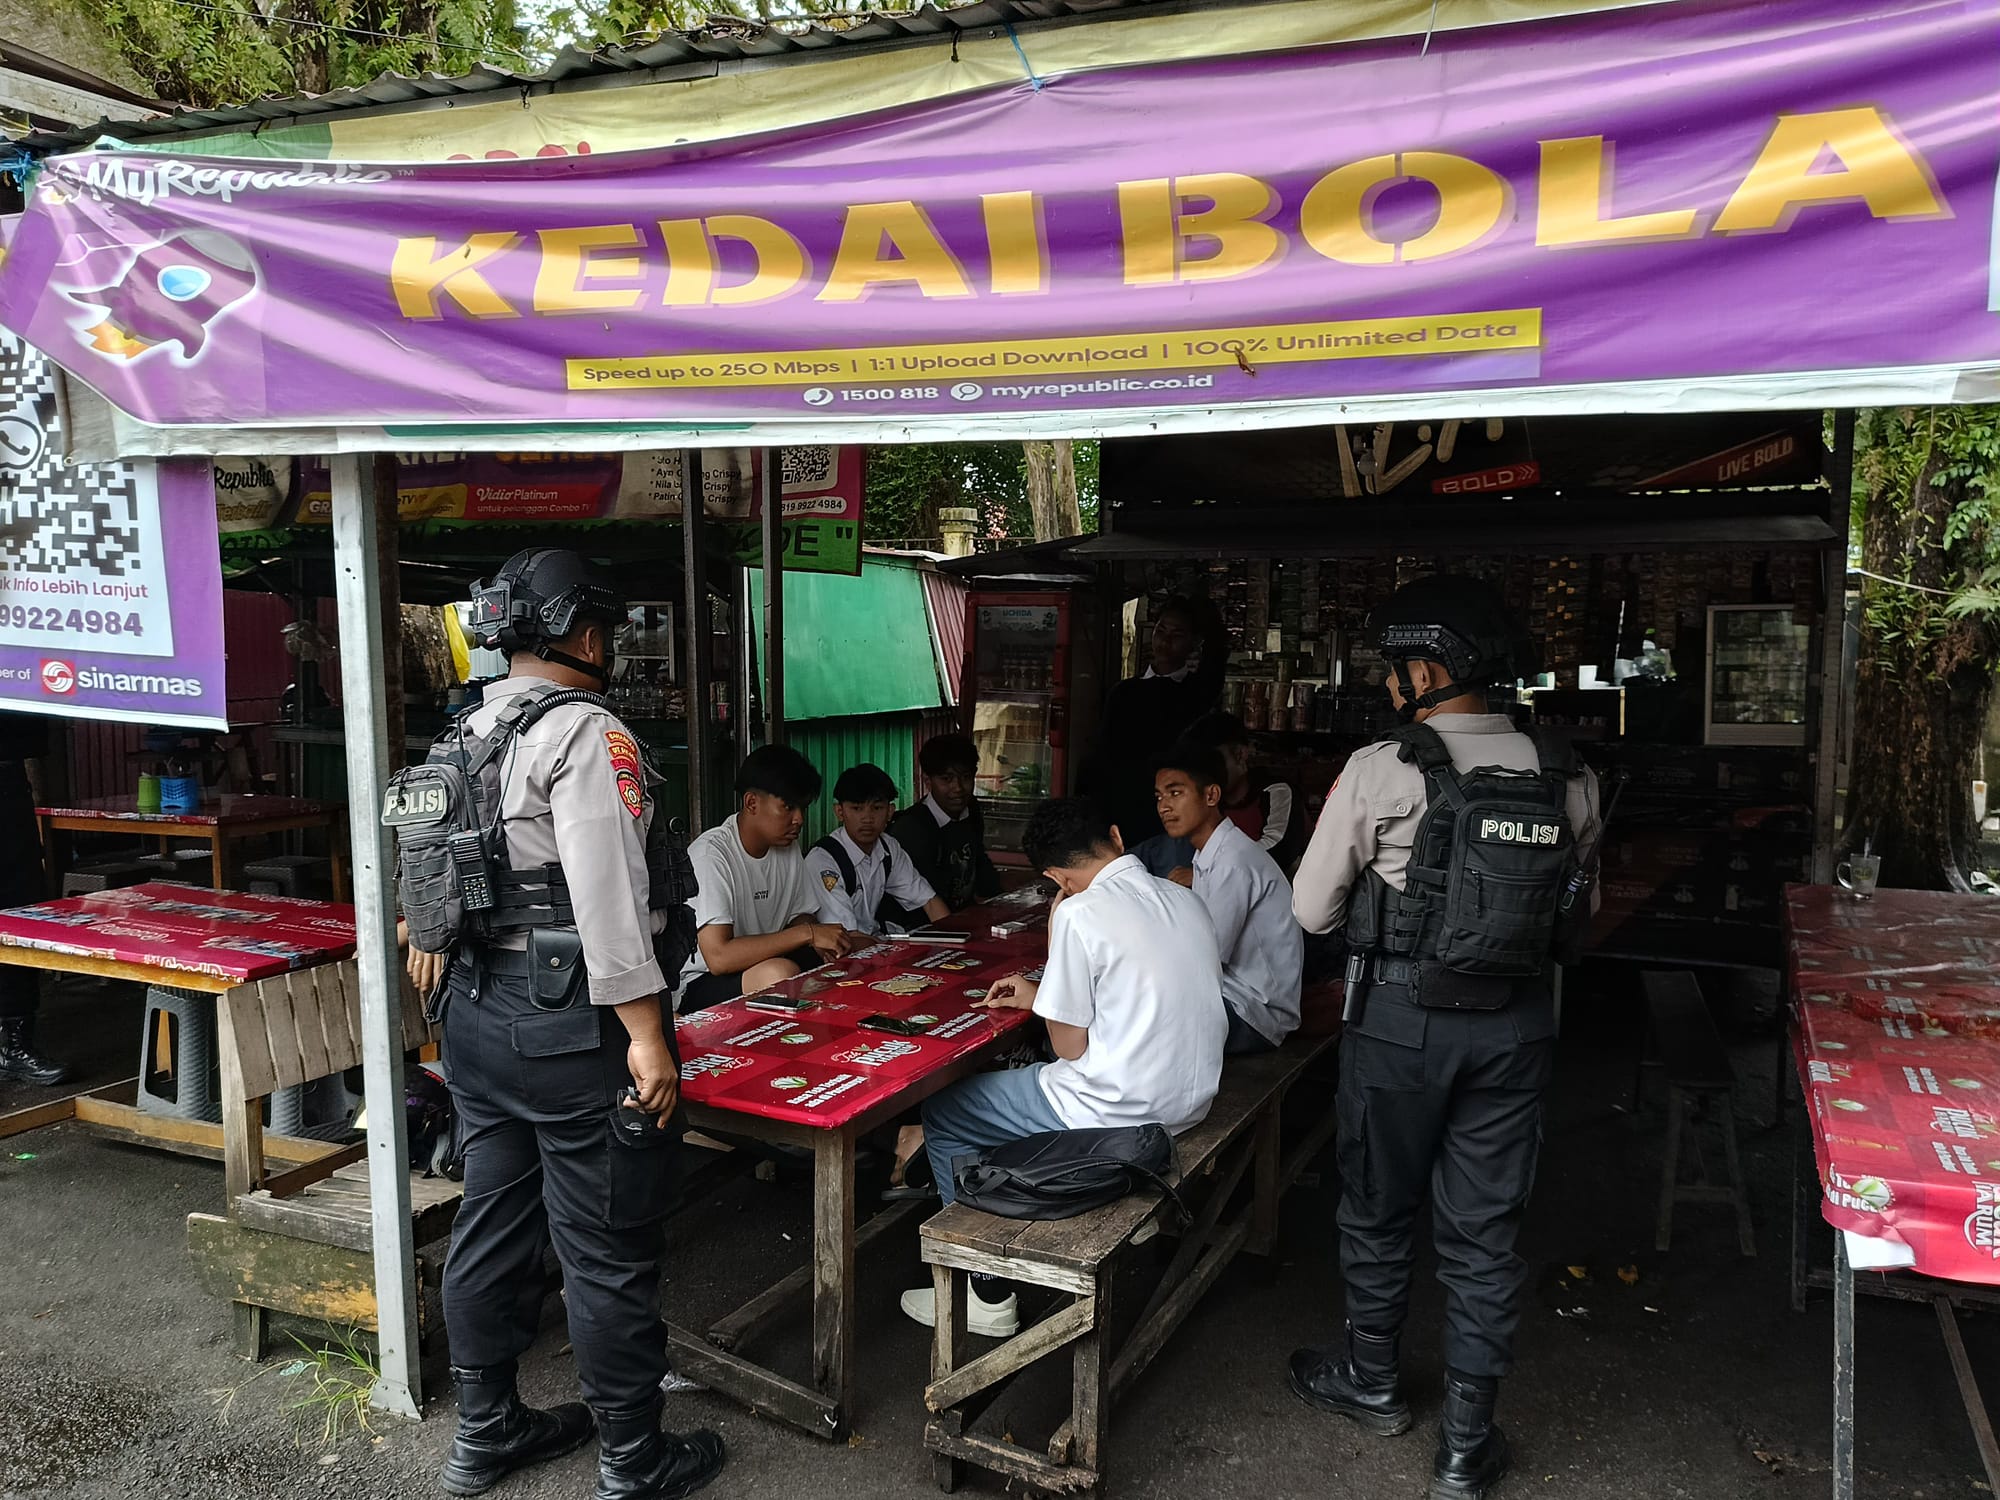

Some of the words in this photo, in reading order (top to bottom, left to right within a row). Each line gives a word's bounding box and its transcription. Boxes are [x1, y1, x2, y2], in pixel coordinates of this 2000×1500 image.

[86, 159, 393, 206] MyRepublic
[391, 190, 1047, 319] KEDAI
[1115, 107, 1950, 288] BOLA
[583, 366, 651, 382] Speed
[657, 367, 684, 380] up
[690, 364, 714, 378] to
[719, 362, 766, 377] 250
[774, 359, 840, 376] Mbps
[869, 358, 895, 372] 1:1
[901, 353, 995, 370] Upload
[1003, 344, 1148, 366] Download
[1183, 338, 1266, 357] 100%
[1277, 329, 1426, 352] Unlimited
[1436, 323, 1517, 342] Data
[841, 387, 895, 401] 1500
[900, 386, 938, 400] 818
[992, 374, 1213, 400] myrepublic.co.id
[1718, 454, 1751, 481] LIVE
[1754, 437, 1793, 466] BOLD
[655, 481, 672, 489] Nila
[704, 482, 733, 492] Crispy
[1442, 469, 1514, 493] BOLD
[476, 487, 514, 501] Vidio
[514, 488, 558, 500] Platinum
[653, 492, 675, 501] Patin
[708, 494, 737, 504] Crispy
[818, 499, 842, 509] 4984
[14, 578, 38, 592] Info
[42, 580, 88, 595] Lebih
[93, 582, 148, 601] Lanjut
[17, 669, 31, 680] of
[78, 666, 202, 696] sinarmas
[385, 788, 446, 817] POLISI
[1481, 819, 1559, 844] POLISI
